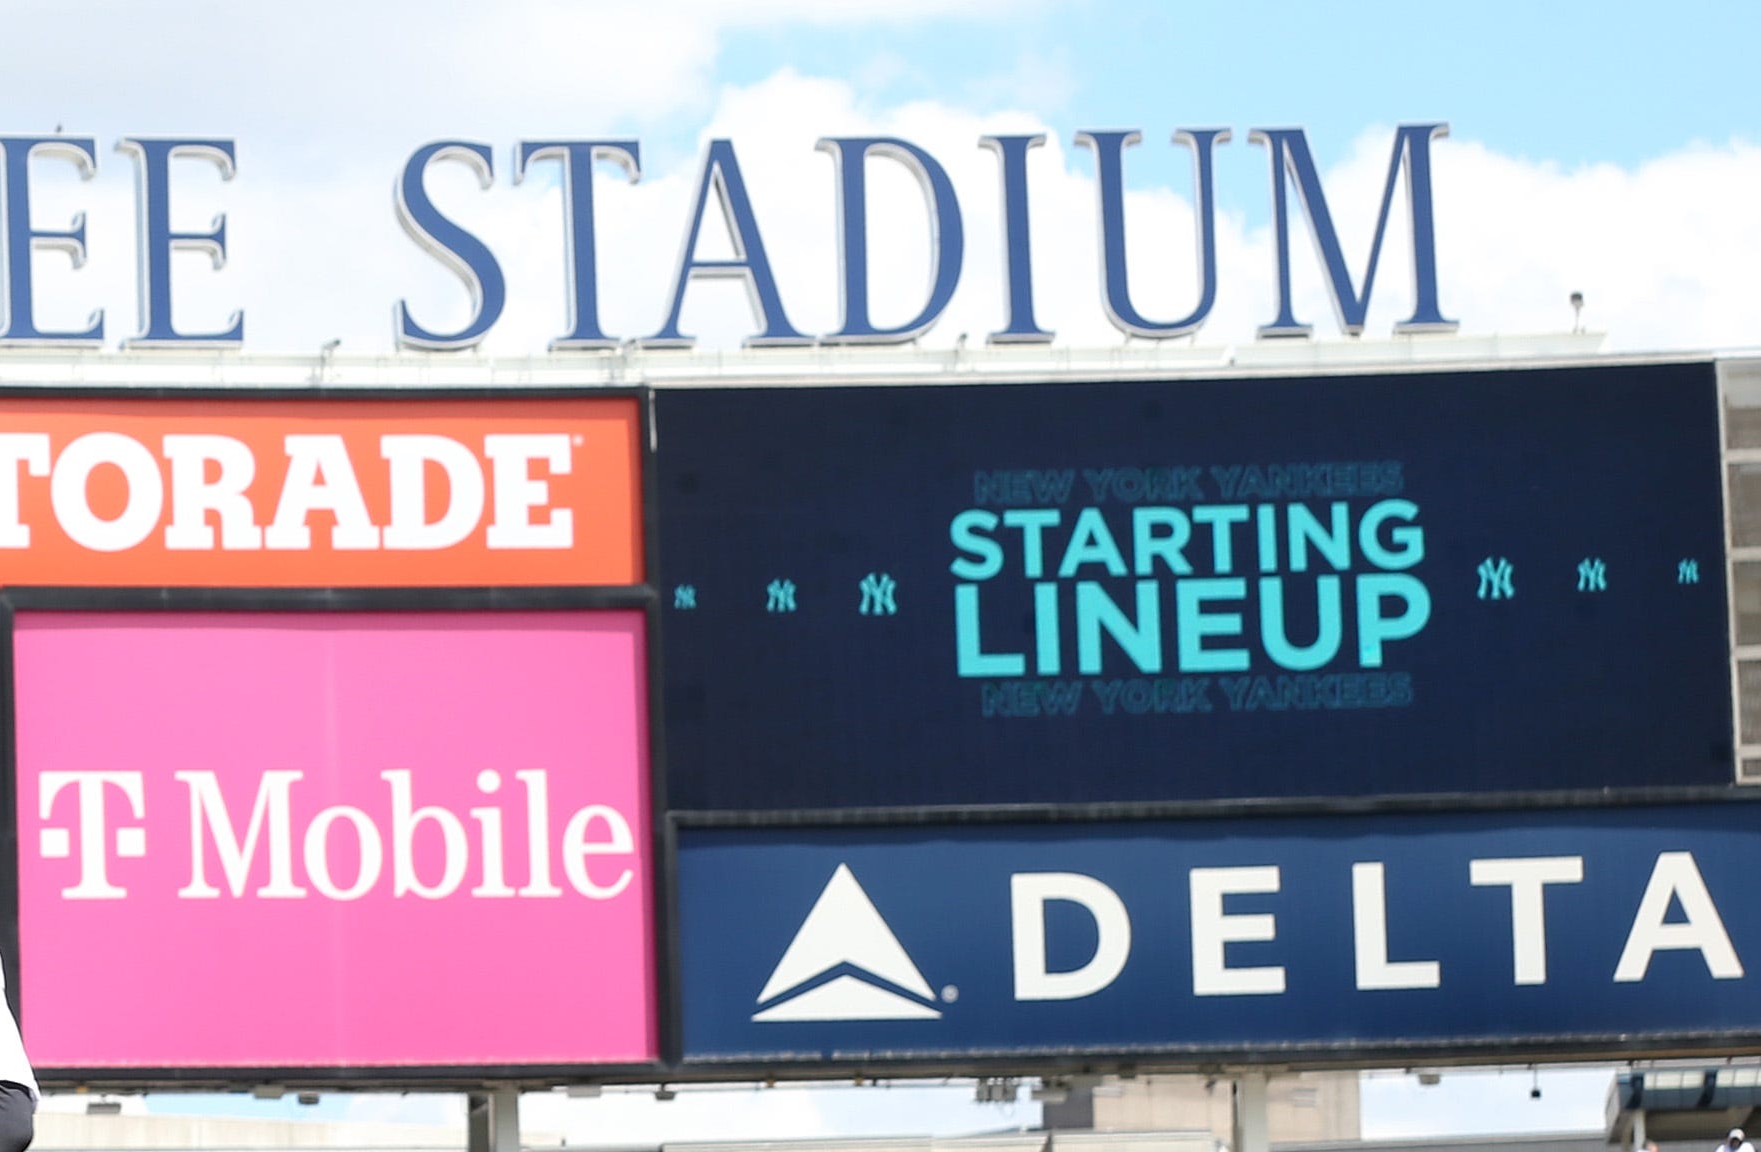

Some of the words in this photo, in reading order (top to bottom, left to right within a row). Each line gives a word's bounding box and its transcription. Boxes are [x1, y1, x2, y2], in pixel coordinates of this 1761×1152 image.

[394, 122, 1461, 355] STADIUM
[973, 467, 1075, 505] NEW
[1082, 463, 1205, 502] YORK
[1208, 459, 1405, 499] YANKEES
[949, 498, 1426, 582] STARTING
[953, 572, 1432, 678] LINEUP
[980, 680, 1083, 718] NEW
[1092, 676, 1212, 714] YORK
[1215, 671, 1414, 712] YANKEES
[175, 769, 635, 901] Mobile
[1010, 852, 1744, 1000] DELTA
